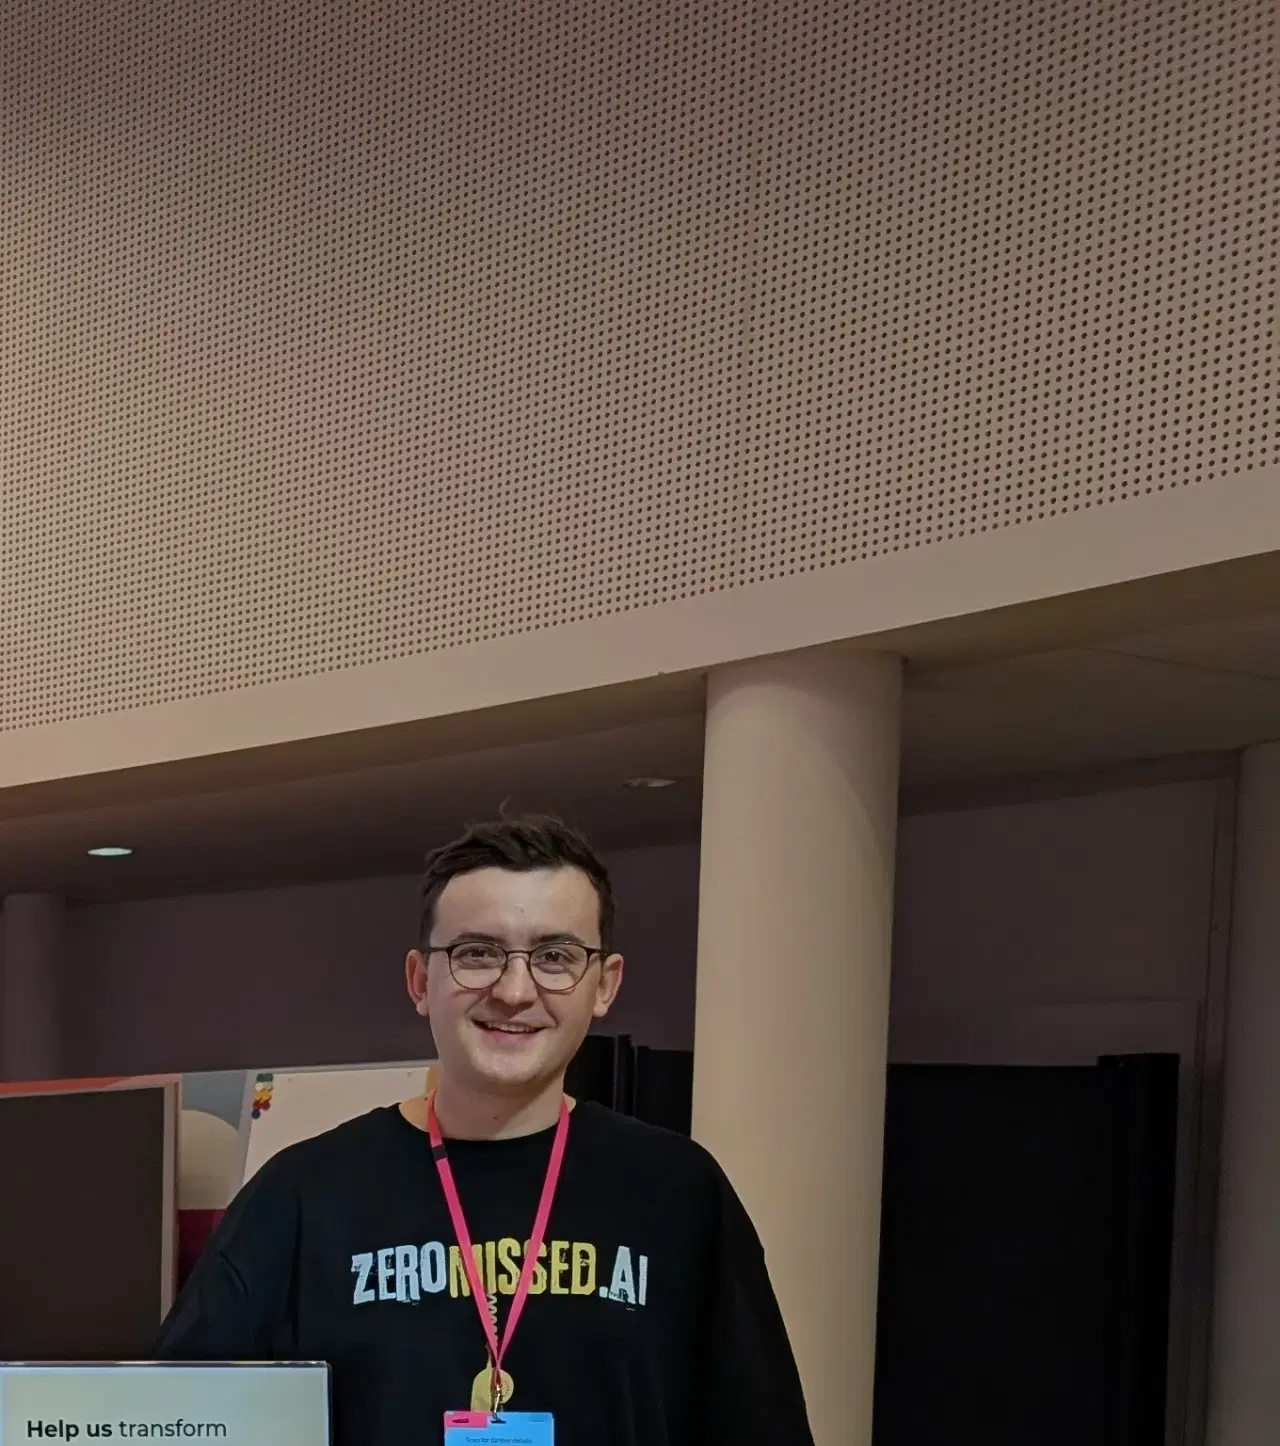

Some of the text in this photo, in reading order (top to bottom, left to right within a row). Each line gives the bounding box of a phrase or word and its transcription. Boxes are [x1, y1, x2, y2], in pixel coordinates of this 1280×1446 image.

[27, 1418, 227, 1442] Help us transform
